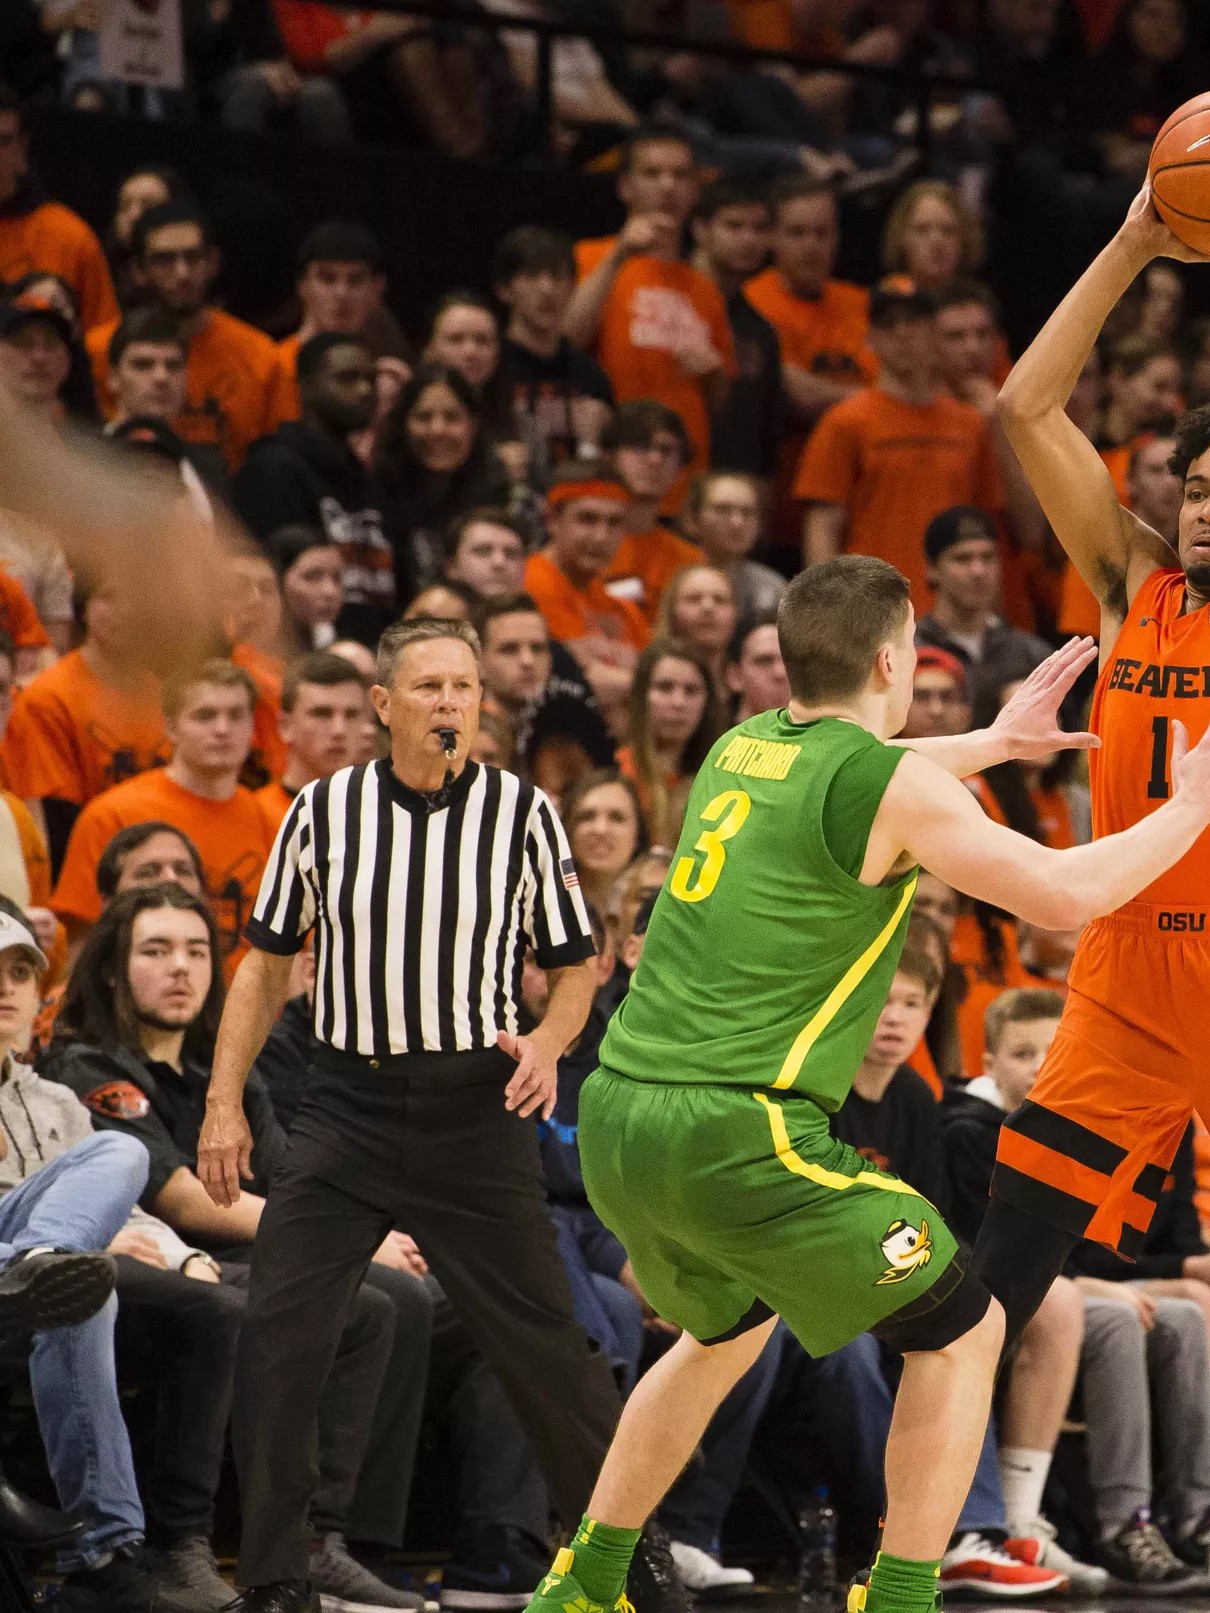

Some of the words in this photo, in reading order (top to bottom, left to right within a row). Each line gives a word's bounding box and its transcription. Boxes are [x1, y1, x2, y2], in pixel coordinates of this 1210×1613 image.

[1147, 716, 1169, 799] 1
[670, 790, 752, 902] 3
[1158, 911, 1206, 932] OSU
